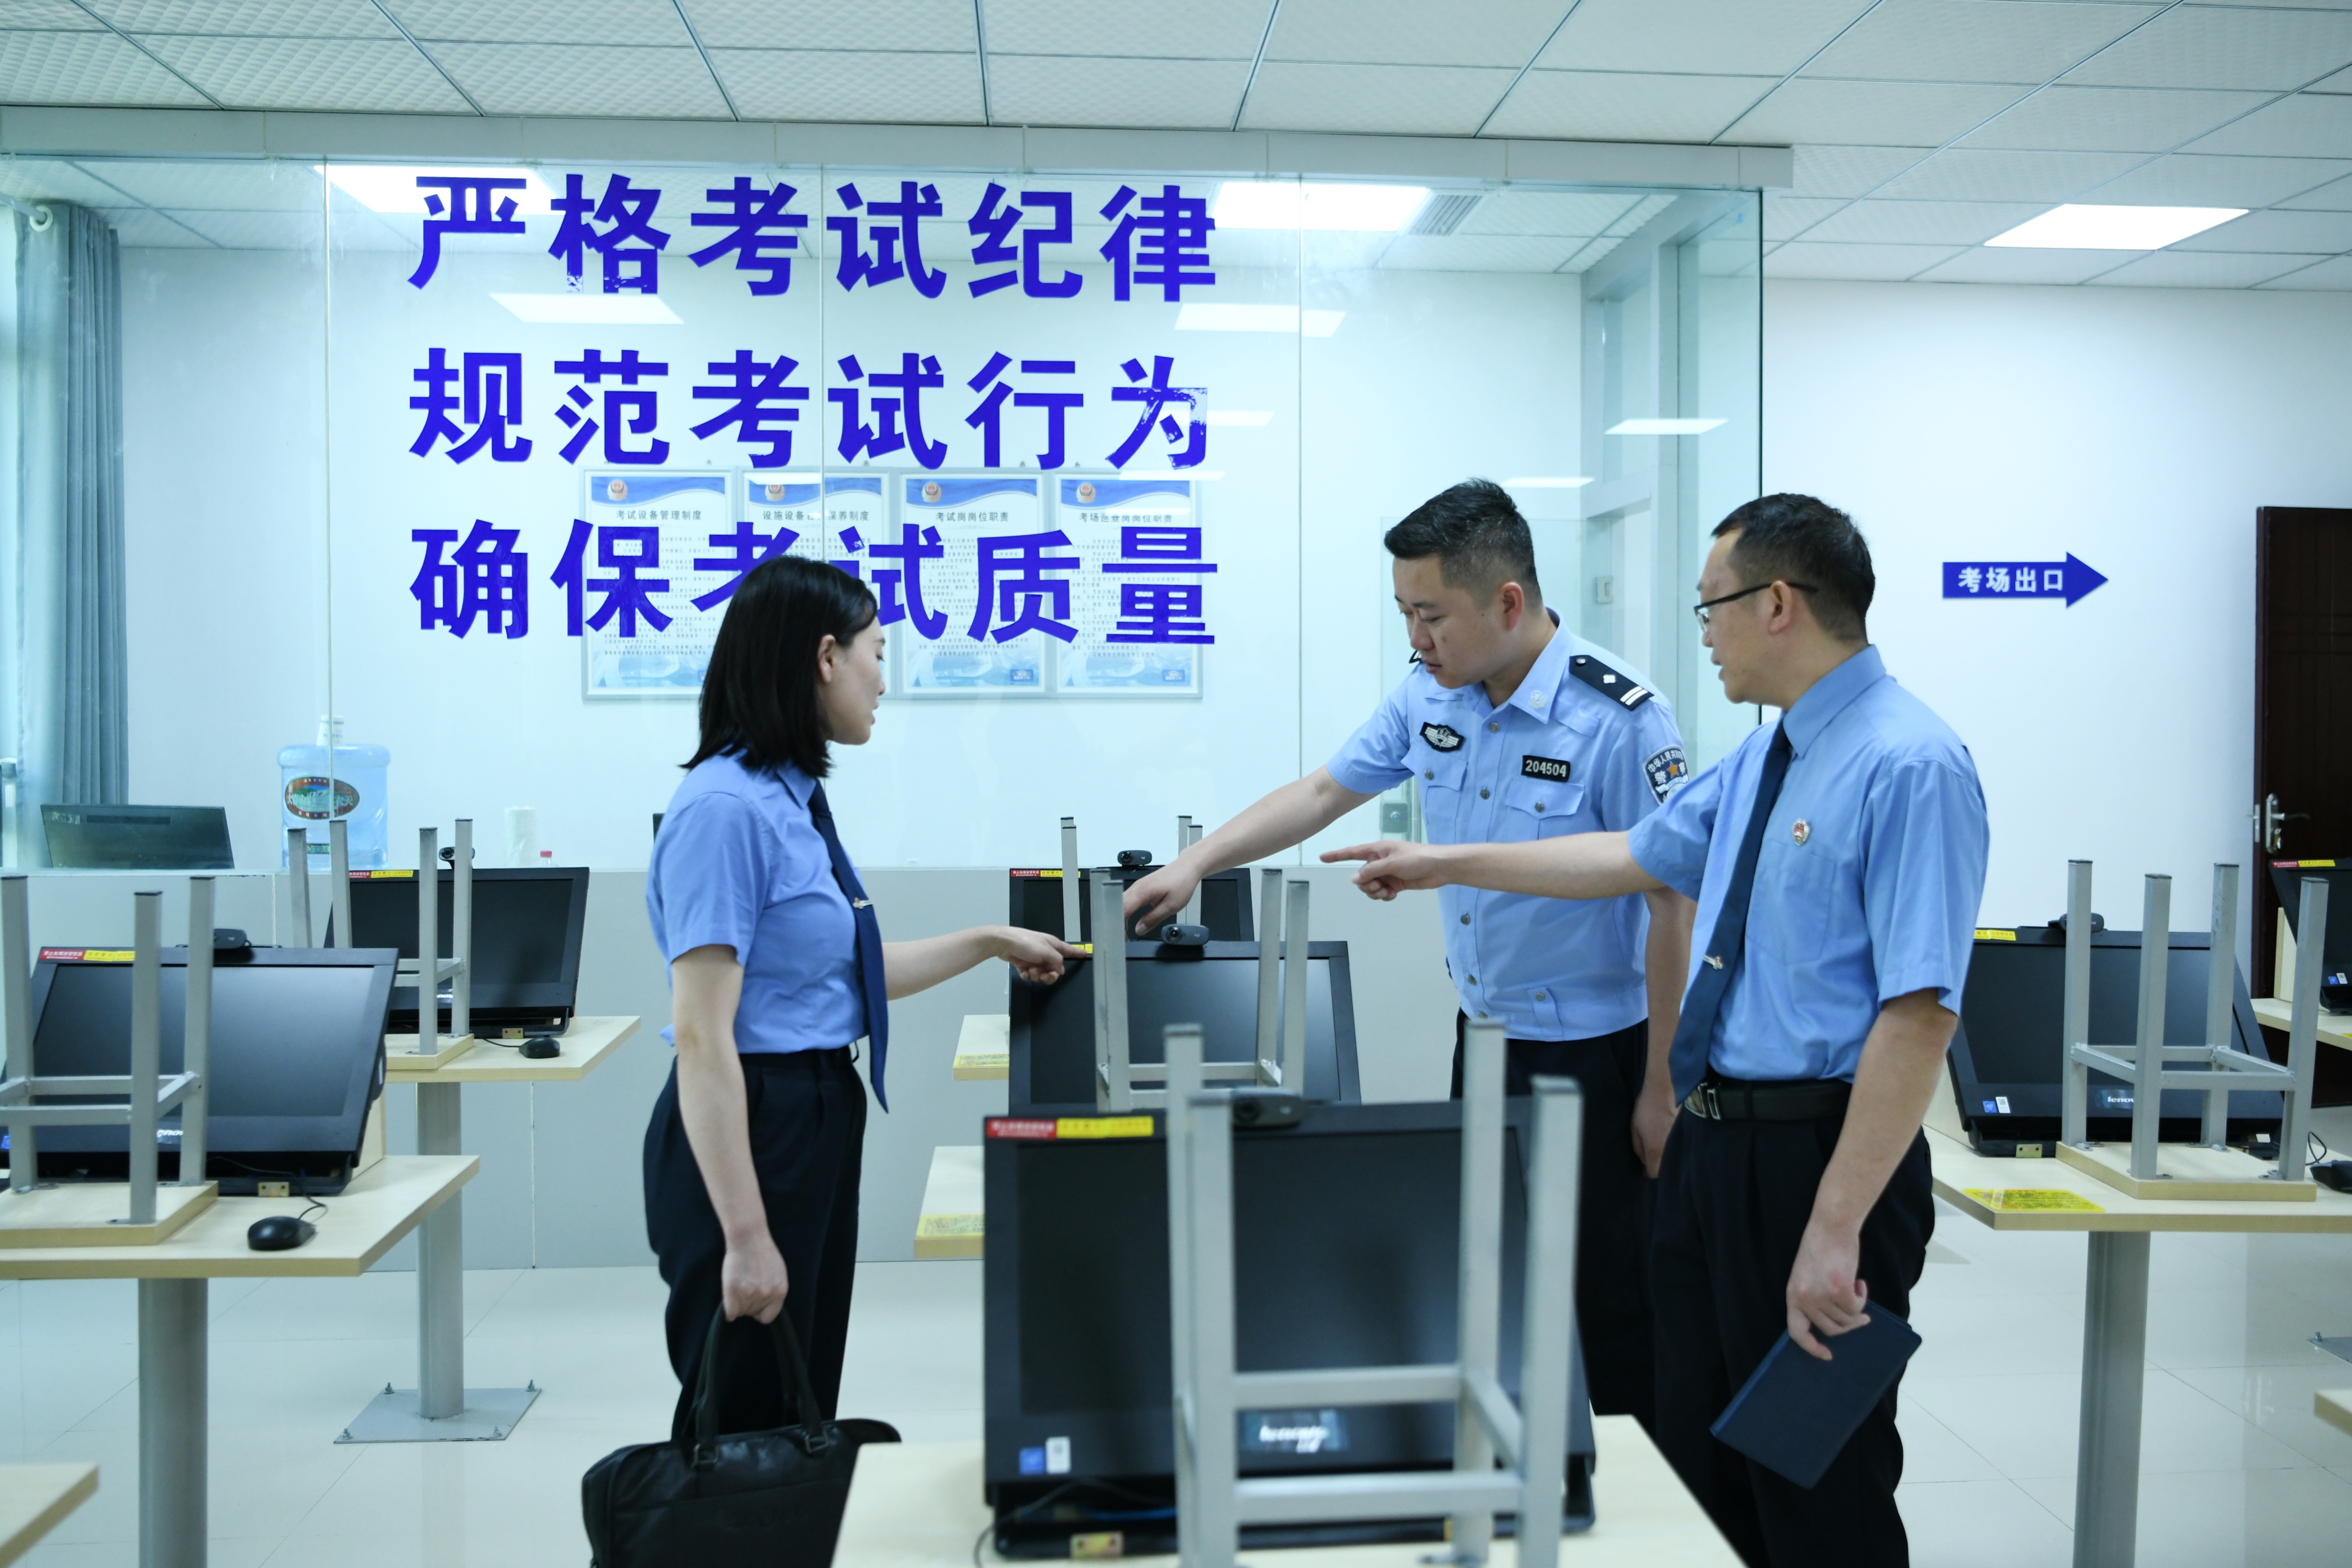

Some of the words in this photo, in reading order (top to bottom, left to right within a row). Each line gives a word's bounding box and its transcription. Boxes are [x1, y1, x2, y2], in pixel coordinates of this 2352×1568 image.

[409, 174, 1215, 301] 严格考试纪律
[410, 348, 1206, 469] 规范考试行为
[616, 510, 702, 521] 考试设备管理制度
[763, 511, 869, 521] 设施设备保养制度
[935, 512, 1009, 522] 考试岗岗位职责
[410, 519, 1217, 643] 确保考试质量
[1958, 566, 2063, 593] 考场出口
[1525, 760, 1566, 777] 204504
